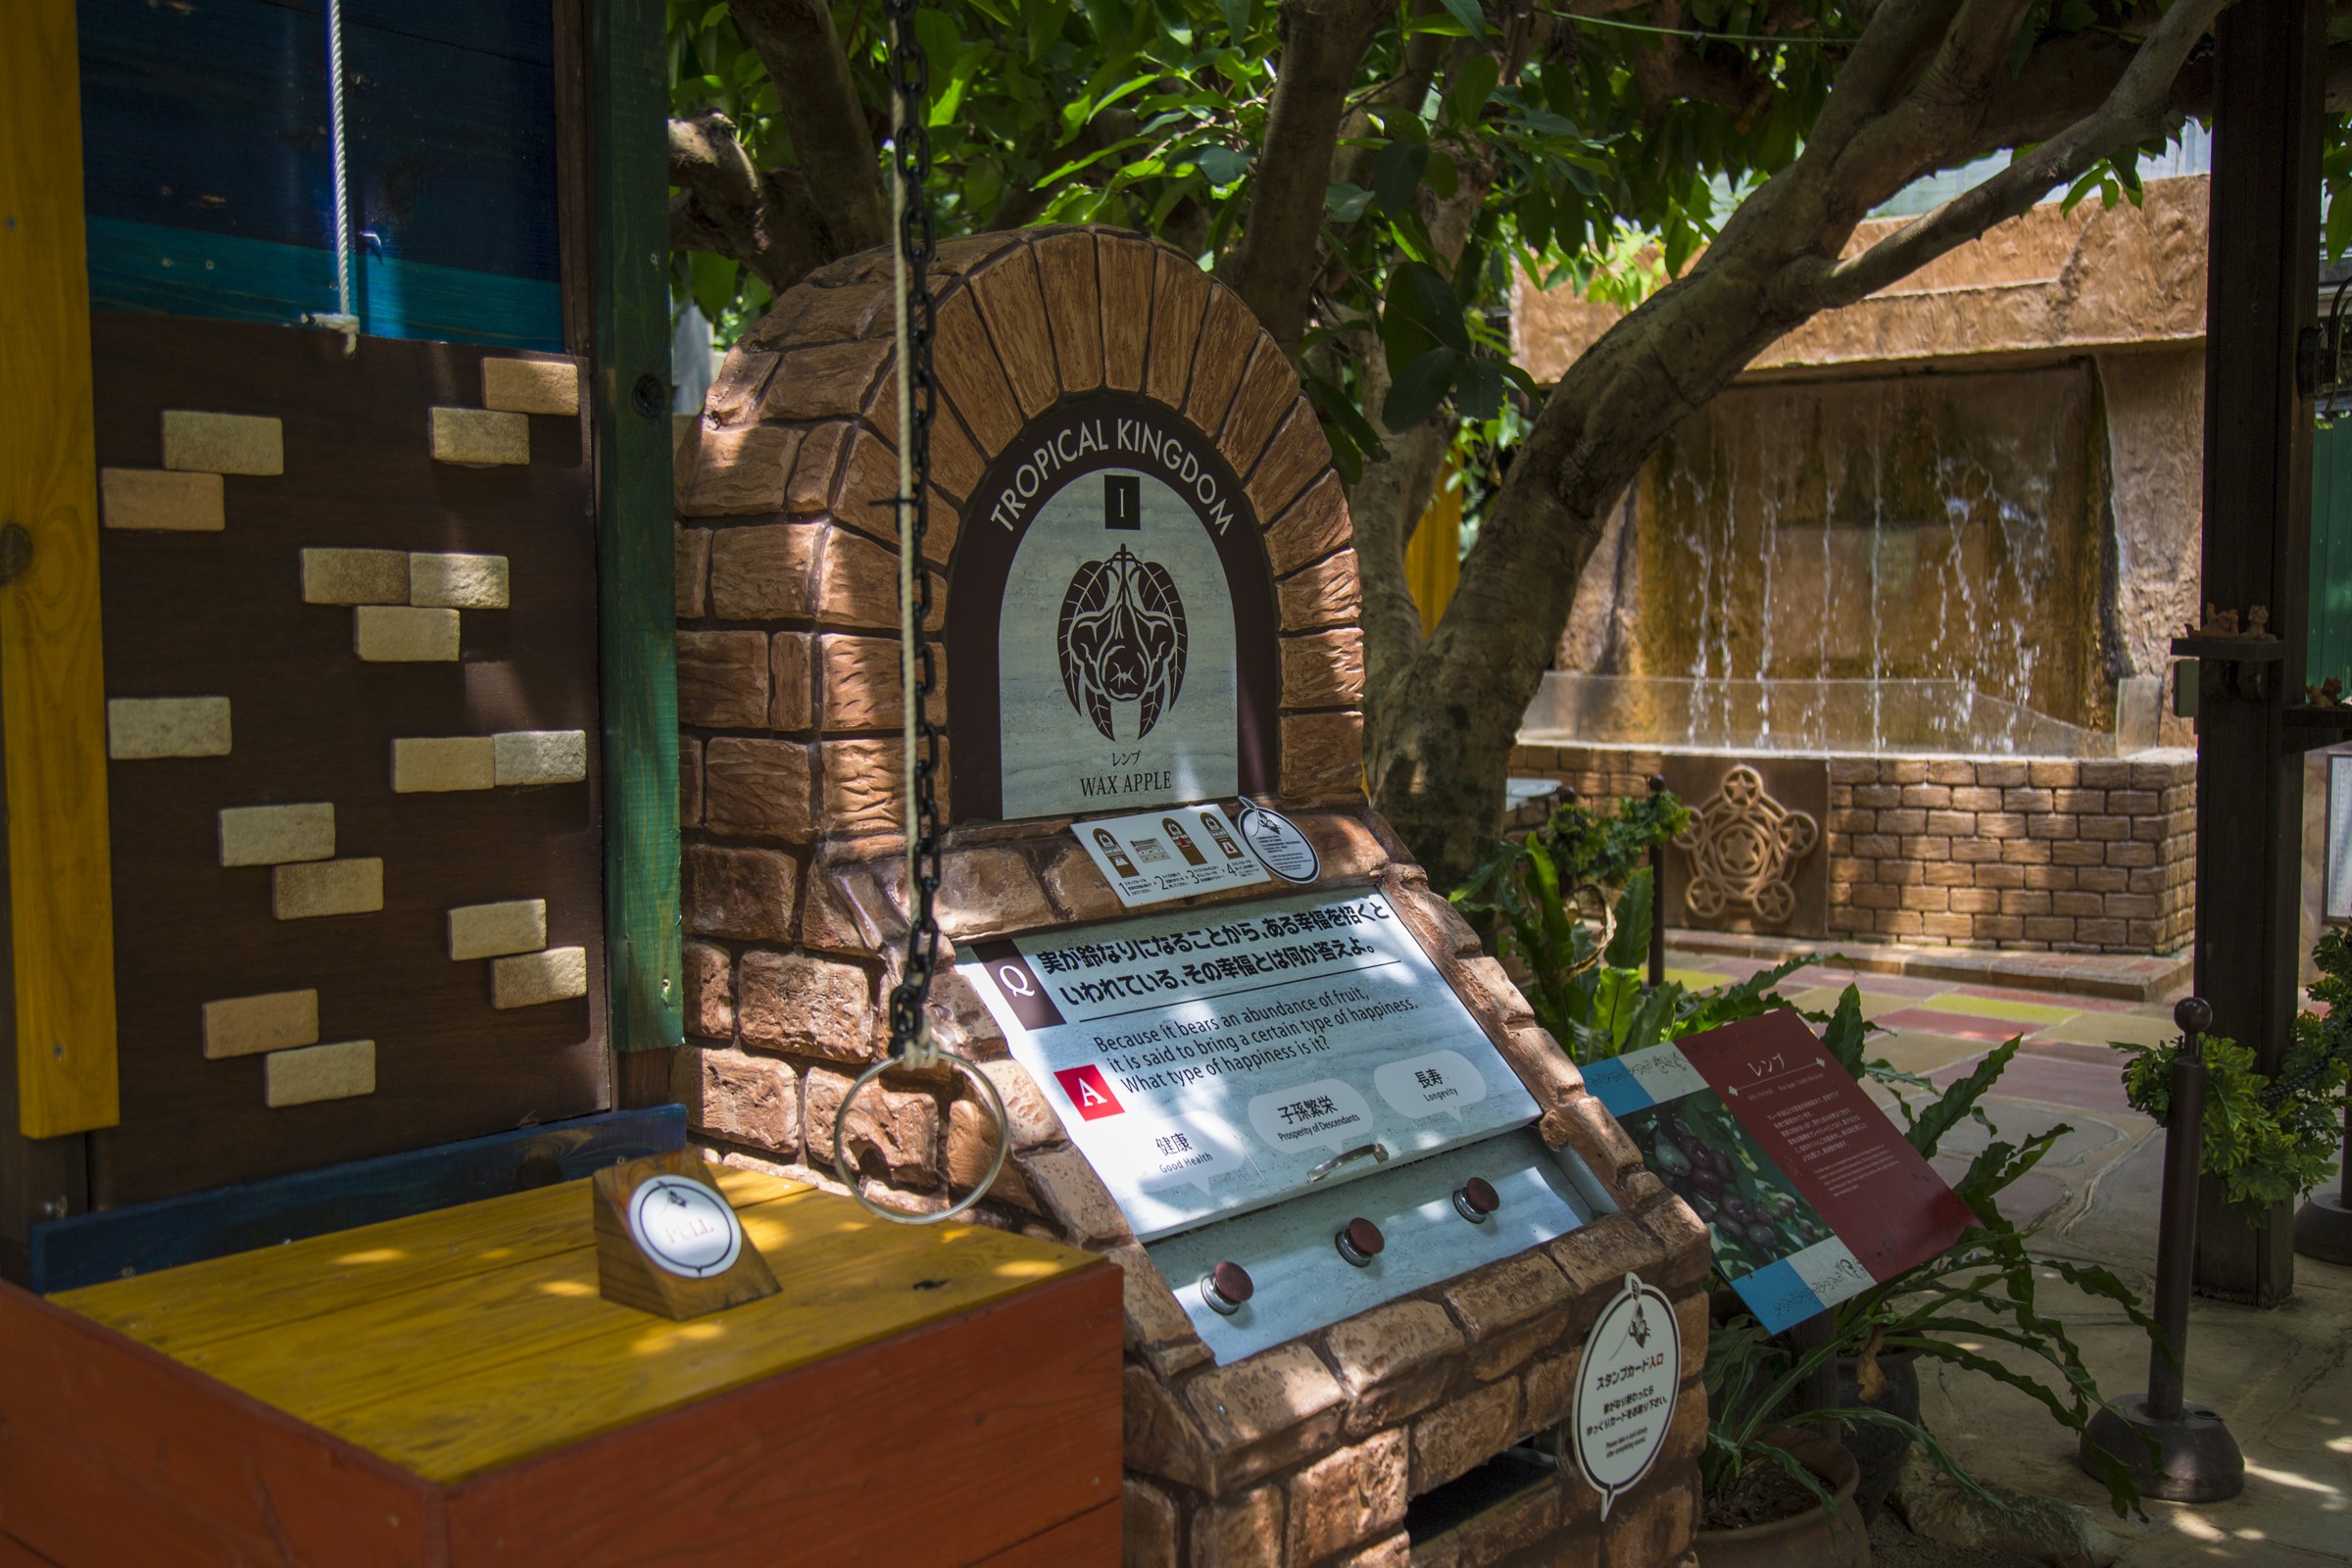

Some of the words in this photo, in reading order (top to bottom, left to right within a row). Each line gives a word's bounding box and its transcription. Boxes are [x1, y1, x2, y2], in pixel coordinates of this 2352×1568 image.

[990, 419, 1108, 532] TROPICAL
[1117, 418, 1234, 536] KINGDOM
[1111, 750, 1141, 767] レンブ
[1080, 775, 1118, 797] WAX
[1124, 770, 1172, 793] APPLE
[1187, 869, 1200, 885] 3
[1226, 862, 1238, 877] 4
[1119, 883, 1131, 897] 1
[1154, 875, 1169, 891] 2
[998, 965, 1035, 998] Q
[1093, 1029, 1161, 1053] Because
[1159, 1024, 1177, 1039] it
[1174, 1018, 1220, 1036] bears
[1220, 1014, 1242, 1028] an
[1242, 1001, 1318, 1024] abundance
[1319, 990, 1334, 1007] of
[1333, 987, 1369, 1004] fruit,
[1106, 1057, 1125, 1073] it
[1123, 1054, 1141, 1070] is
[1142, 1046, 1176, 1066] said
[1175, 1045, 1195, 1059] to
[1193, 1036, 1240, 1054] bring
[1239, 1034, 1250, 1046] a
[1251, 1022, 1301, 1043] certain
[1300, 1016, 1334, 1035] type
[1334, 1008, 1349, 1025] of
[1120, 1073, 1168, 1093] What
[1167, 1066, 1204, 1087] type
[1205, 1057, 1223, 1075] of
[1220, 1045, 1298, 1072] happiness
[1294, 1041, 1311, 1055] is
[1308, 1035, 1330, 1052] it?
[1747, 1053, 1785, 1077] レンブ
[1414, 1068, 1444, 1089] 長寿
[1078, 1077, 1107, 1107] A
[1423, 1086, 1458, 1102] Longevity
[1277, 1095, 1339, 1124] 子孫繁栄
[1277, 1127, 1313, 1142] Prosperity
[1312, 1122, 1320, 1133] of
[1318, 1114, 1360, 1130] Descendants
[1155, 1133, 1193, 1156] 健康
[1158, 1159, 1184, 1173] Good
[1183, 1152, 1213, 1167] Health
[665, 1217, 714, 1245] PULL
